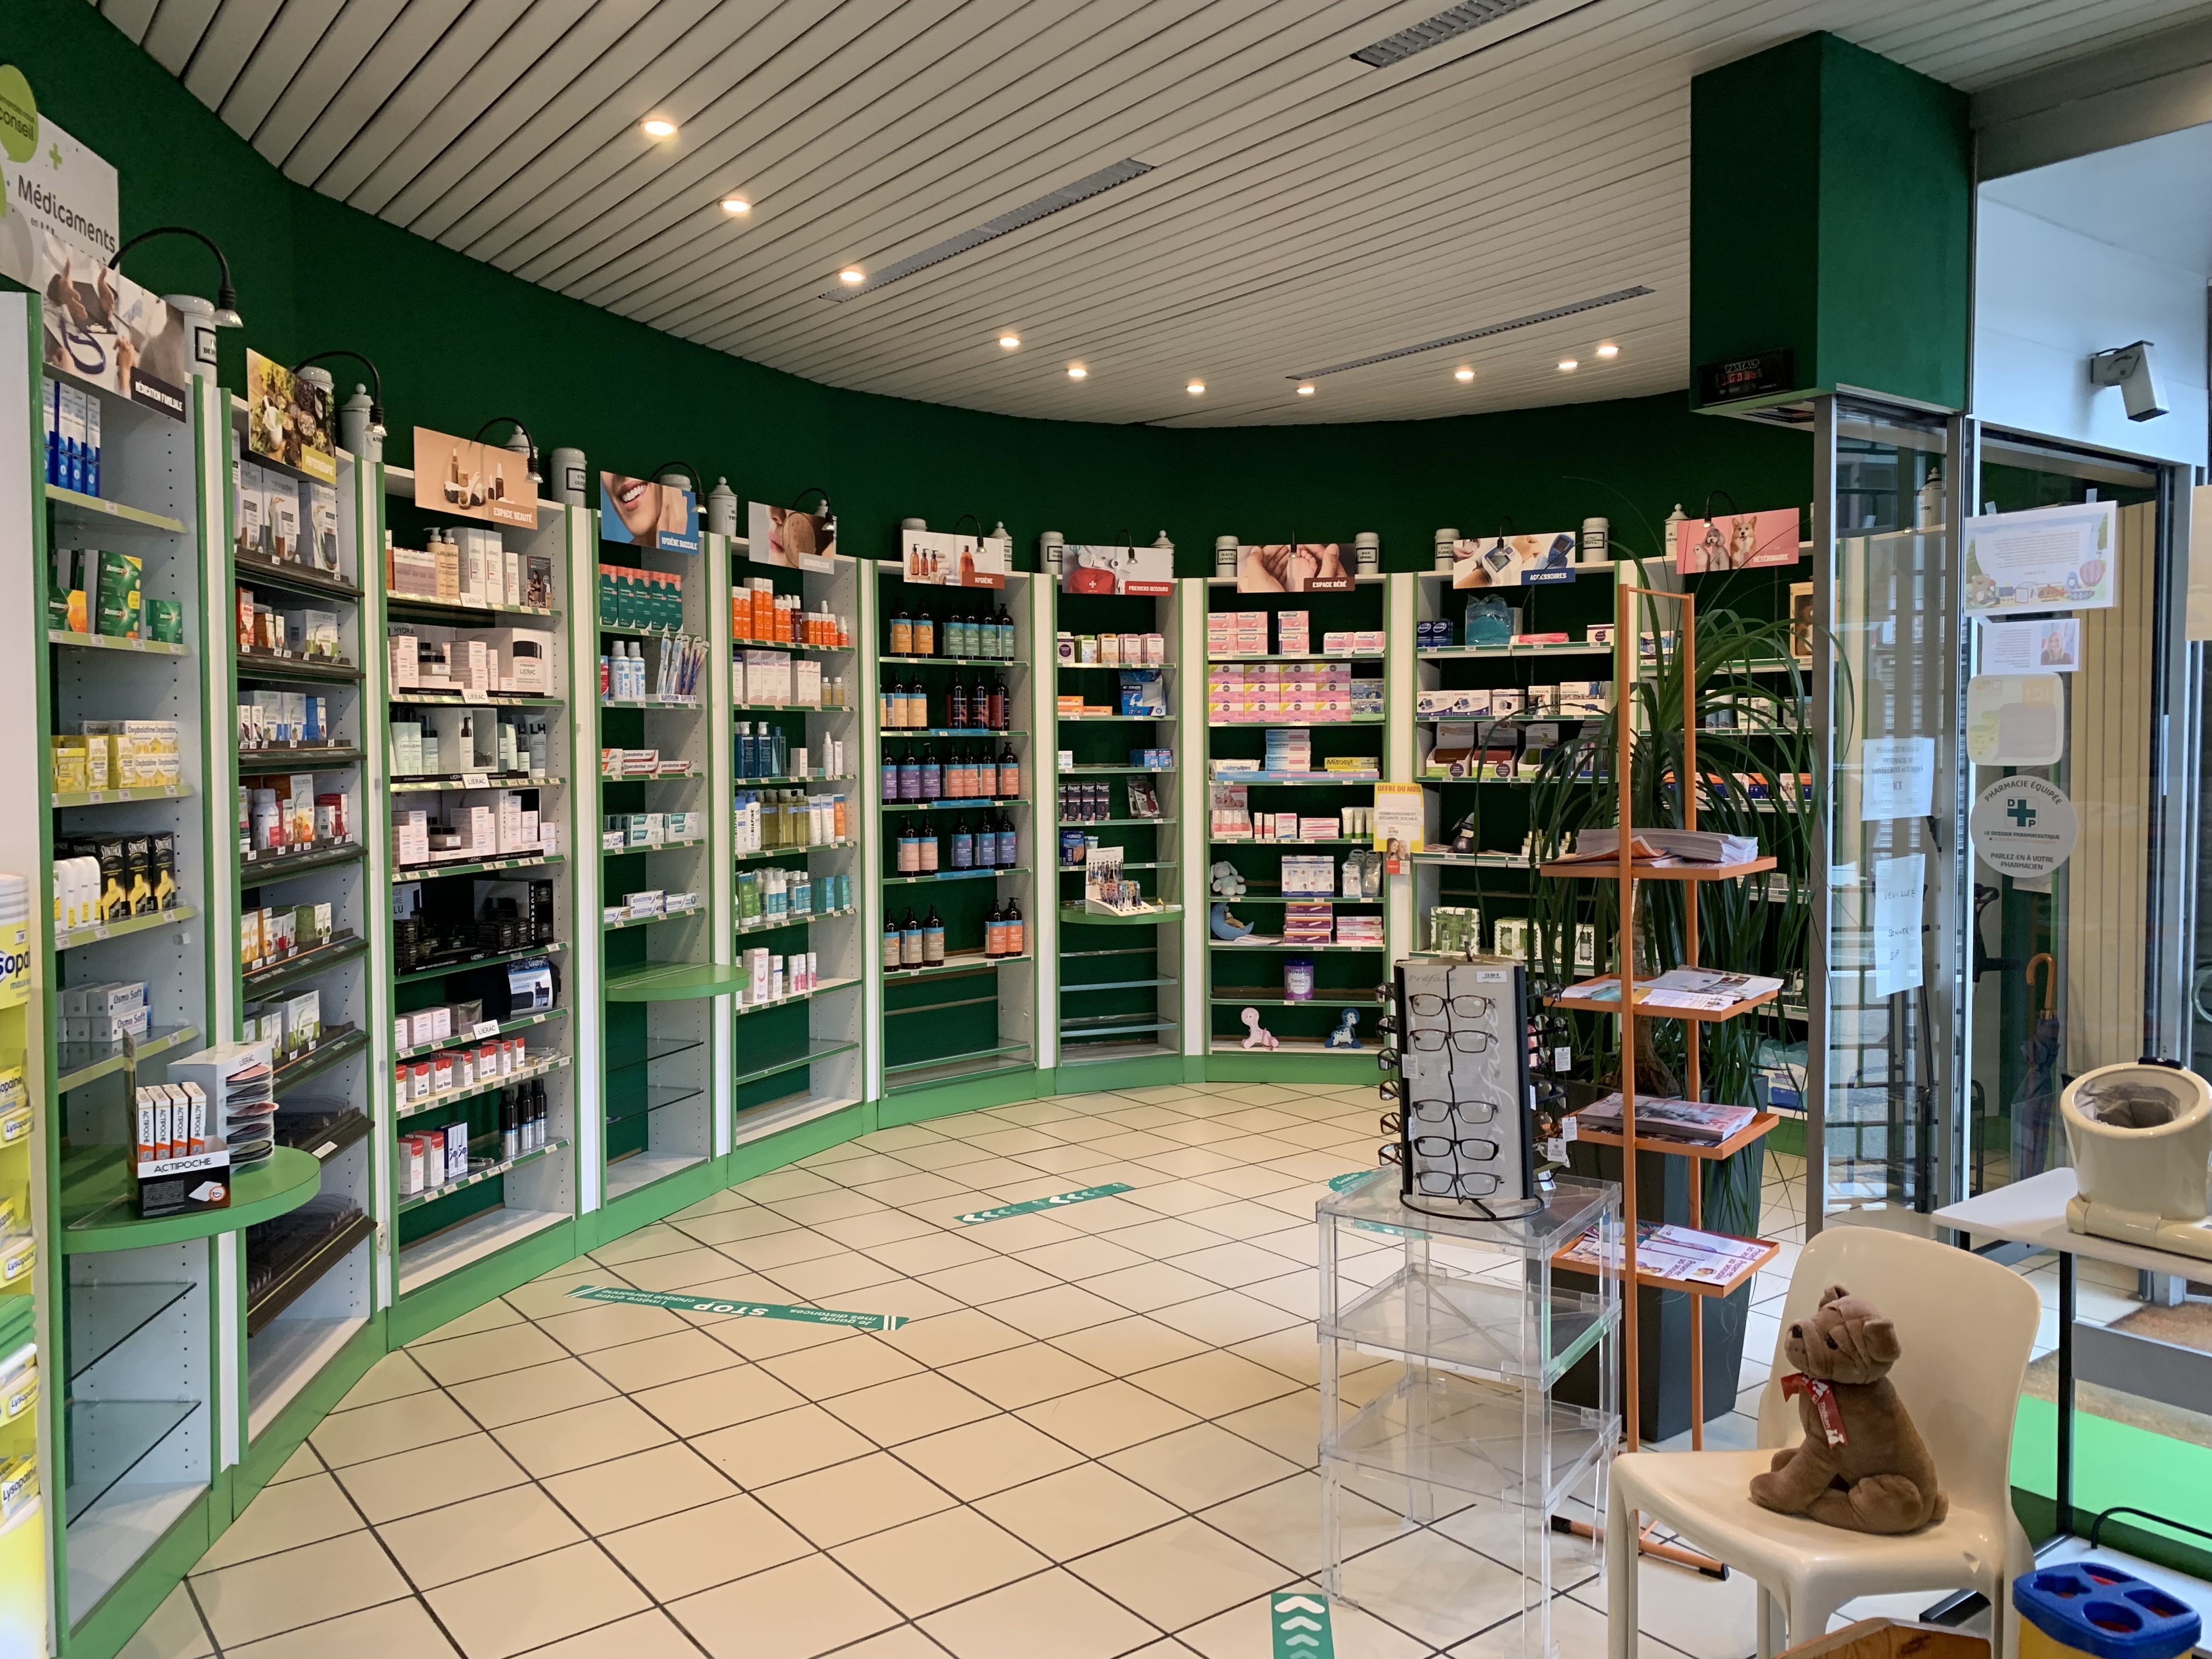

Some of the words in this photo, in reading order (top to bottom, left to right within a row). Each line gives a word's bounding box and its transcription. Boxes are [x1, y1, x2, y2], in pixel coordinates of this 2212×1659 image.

[18, 174, 116, 254] Médicaments
[494, 507, 514, 520] ESPACE
[514, 511, 533, 523] BEAUTÉ
[1753, 552, 1789, 563] VÉTÉRINAIRE
[1530, 572, 1567, 582] ACCESSOIRES
[466, 693, 486, 701] LIERAC
[1893, 781, 1901, 791] ICI
[1984, 780, 2029, 802] PHARMACIE
[2030, 780, 2063, 805] ÉQUIPÉE
[2007, 799, 2015, 807] D
[2013, 832, 2060, 840] PHARMACEUTIQUE
[128, 838, 148, 855] SYNTHOL
[155, 835, 173, 851] SYNTHOL
[100, 842, 122, 860] SYNTHOL
[1990, 852, 2025, 861] PARLEZ-EN
[2027, 853, 2032, 861] À
[2032, 855, 2054, 863] VOTRE
[2001, 861, 2043, 870] PHARMACIEN
[1884, 889, 1915, 900] VEUILLEZ
[393, 905, 404, 914] LU
[1888, 927, 1909, 937] SONNER
[478, 1025, 496, 1035] LIERAC
[239, 1054, 255, 1067] LIERAC
[142, 1110, 150, 1144] ACTIPOCHE
[154, 1156, 212, 1174] ACTIPOCHE
[601, 1289, 652, 1299] personne
[654, 1293, 695, 1303] chaque
[627, 1296, 661, 1305] mètre
[693, 1303, 769, 1316] STOP
[788, 1309, 849, 1319] distances
